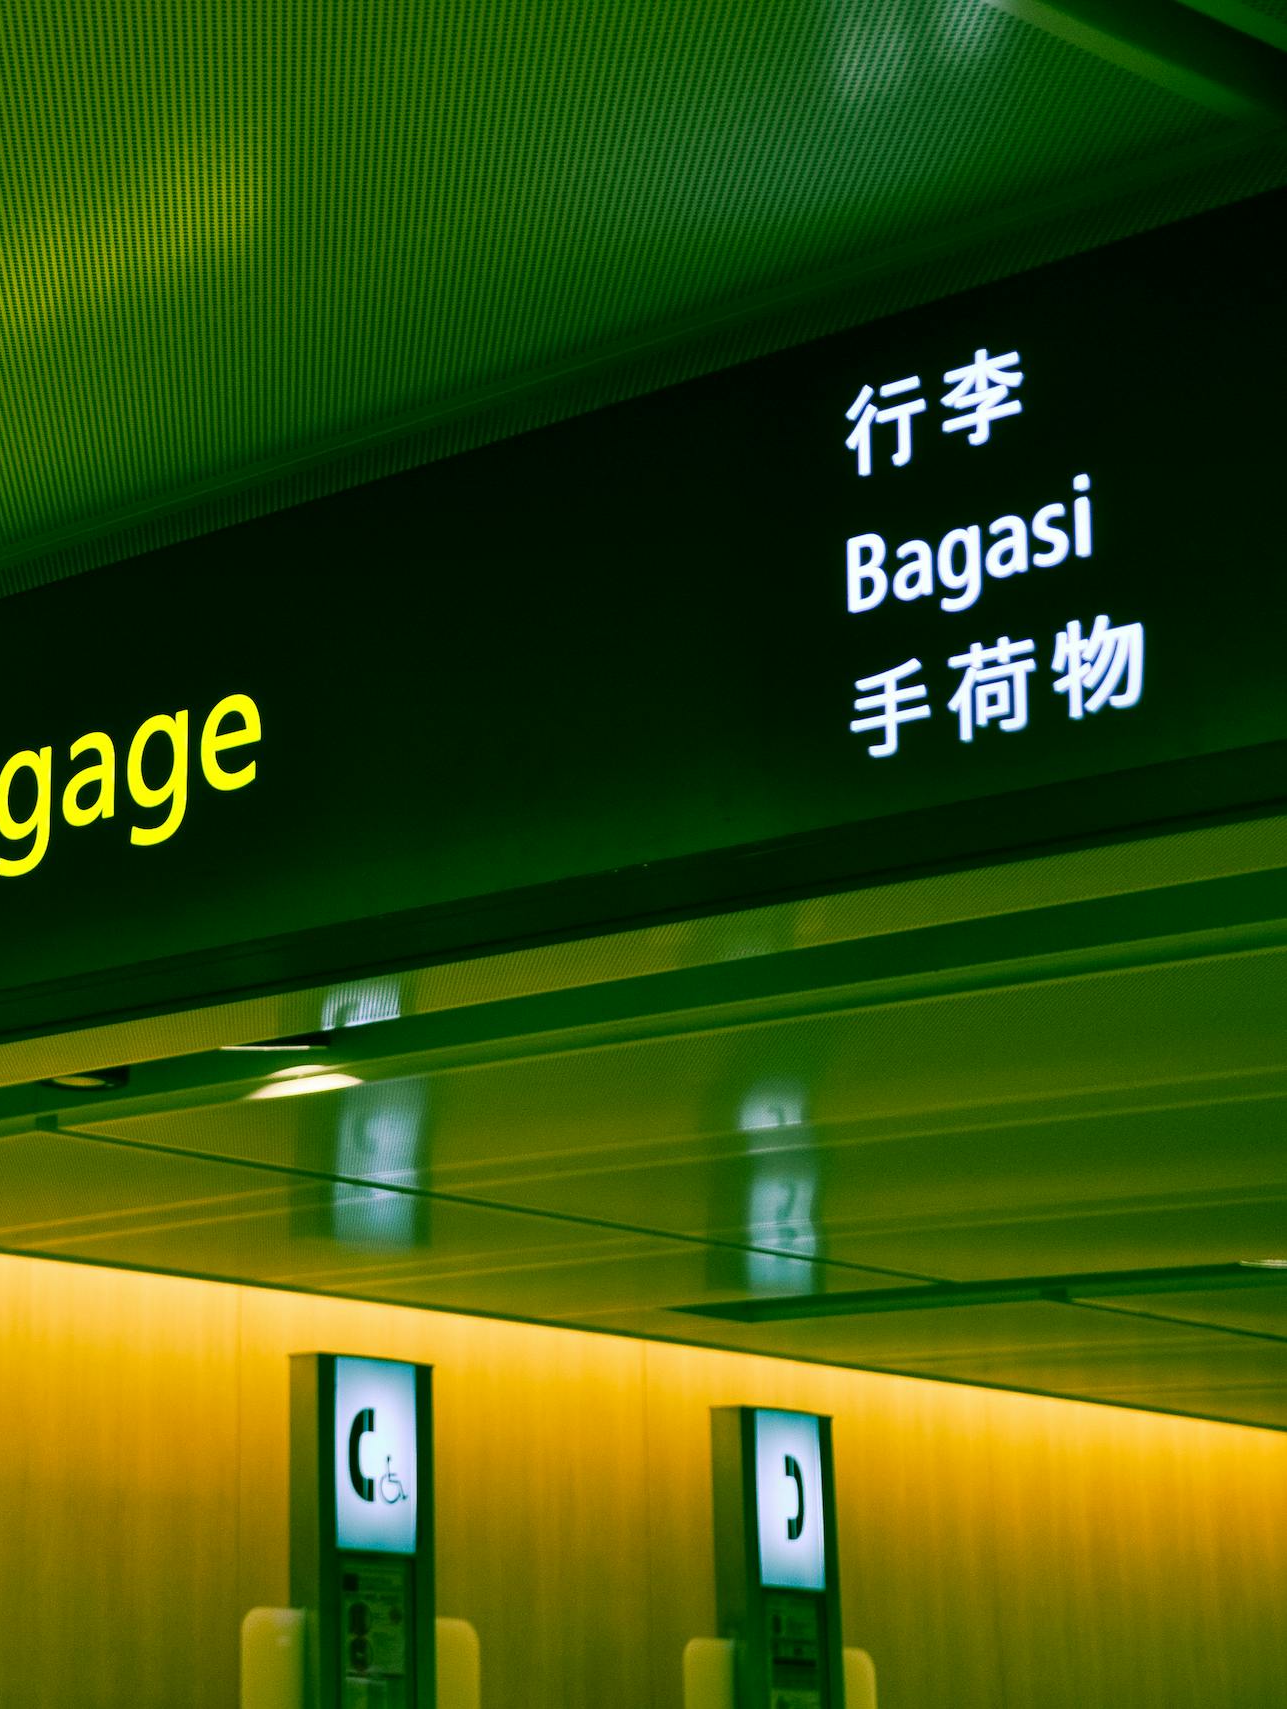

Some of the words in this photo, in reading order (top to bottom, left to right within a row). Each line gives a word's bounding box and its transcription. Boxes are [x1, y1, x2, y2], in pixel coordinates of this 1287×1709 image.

[844, 348, 1025, 477] 行李
[845, 473, 1093, 614] Bagasi
[849, 614, 1145, 759] 手荷物
